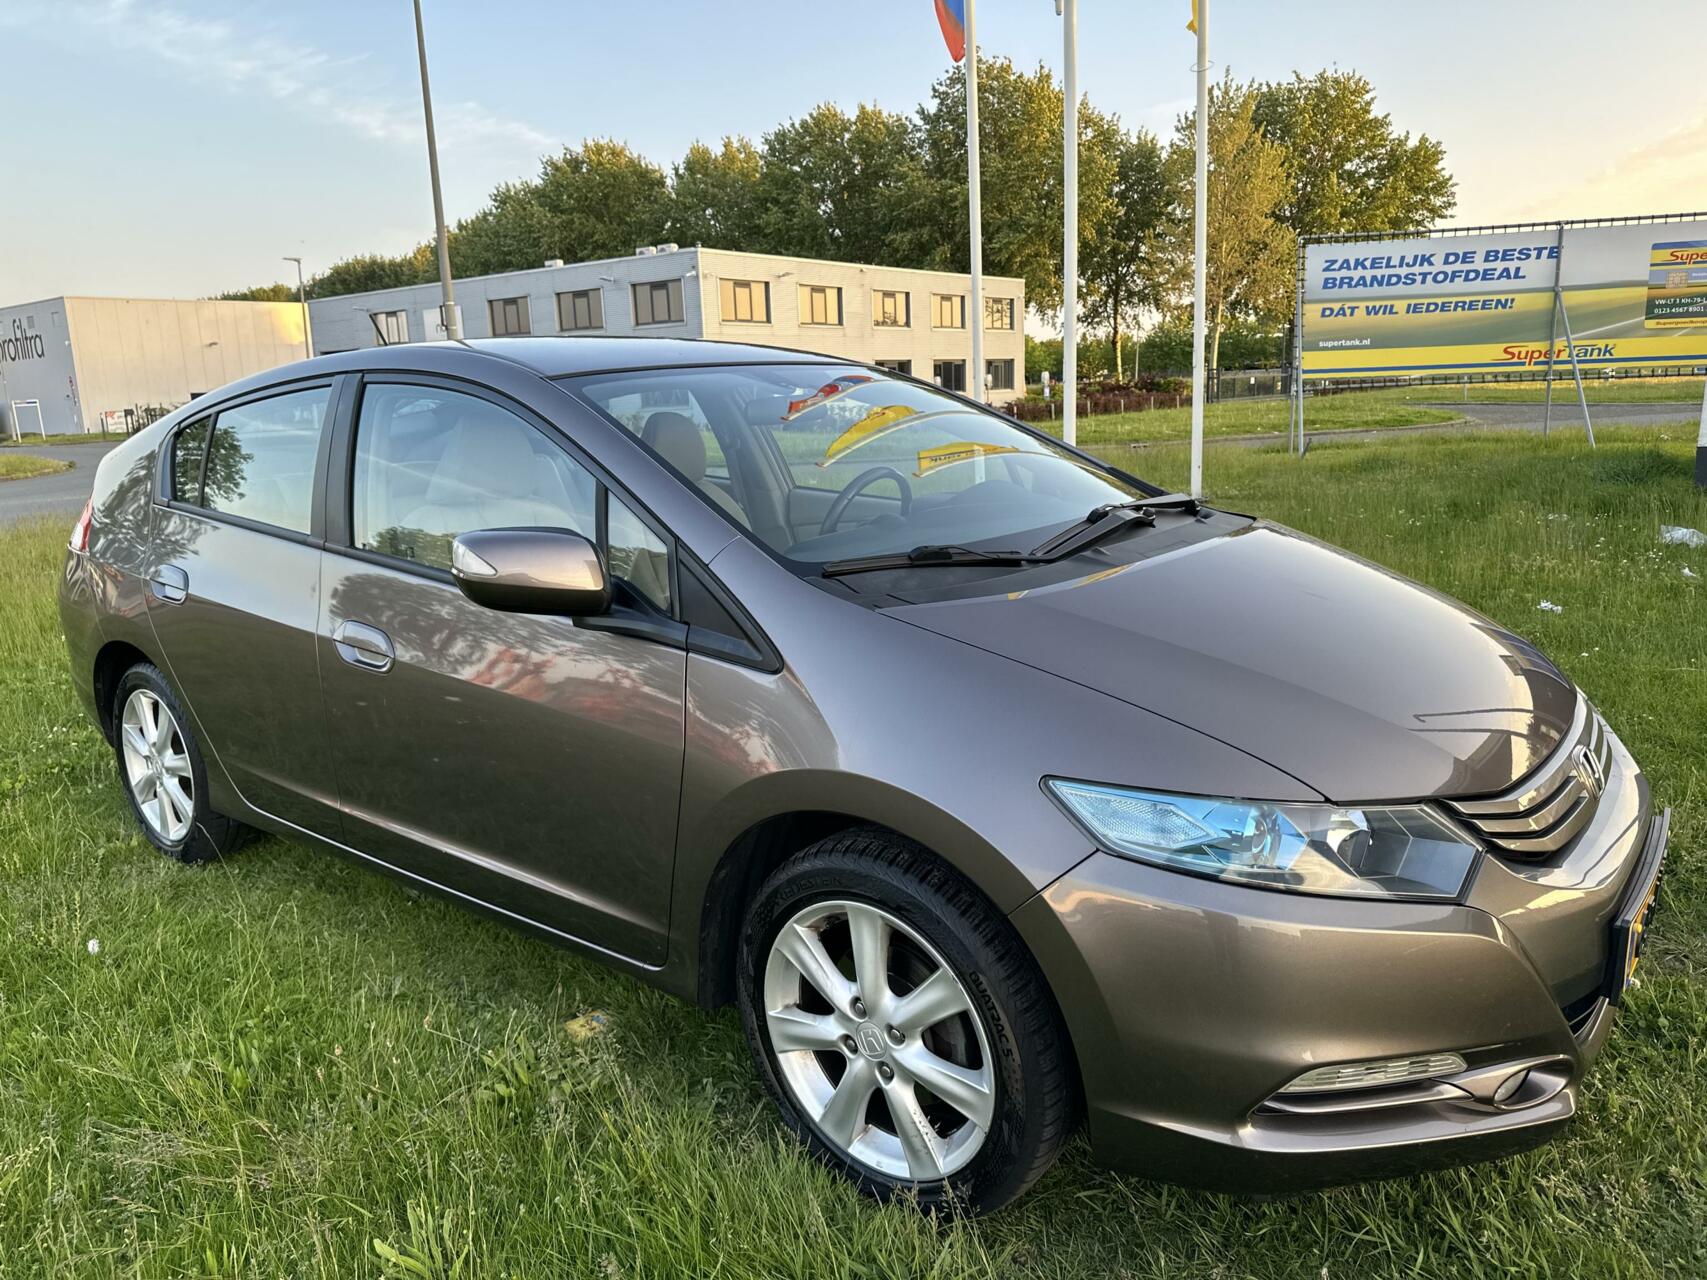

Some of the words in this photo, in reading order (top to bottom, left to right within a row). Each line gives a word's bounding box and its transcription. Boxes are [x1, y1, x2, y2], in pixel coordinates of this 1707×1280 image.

[1322, 253, 1436, 272] ZAKELIJK
[1443, 250, 1477, 265] DE
[1484, 246, 1561, 263] BESTE
[1322, 266, 1526, 290] BRANDSTOFDEAL
[1320, 303, 1359, 318] DÁT
[1365, 303, 1399, 316] WIL
[1405, 298, 1515, 314] IEDEREEN!
[1319, 338, 1371, 348] supertank.nl
[969, 970, 1010, 1044] QUATRAC
